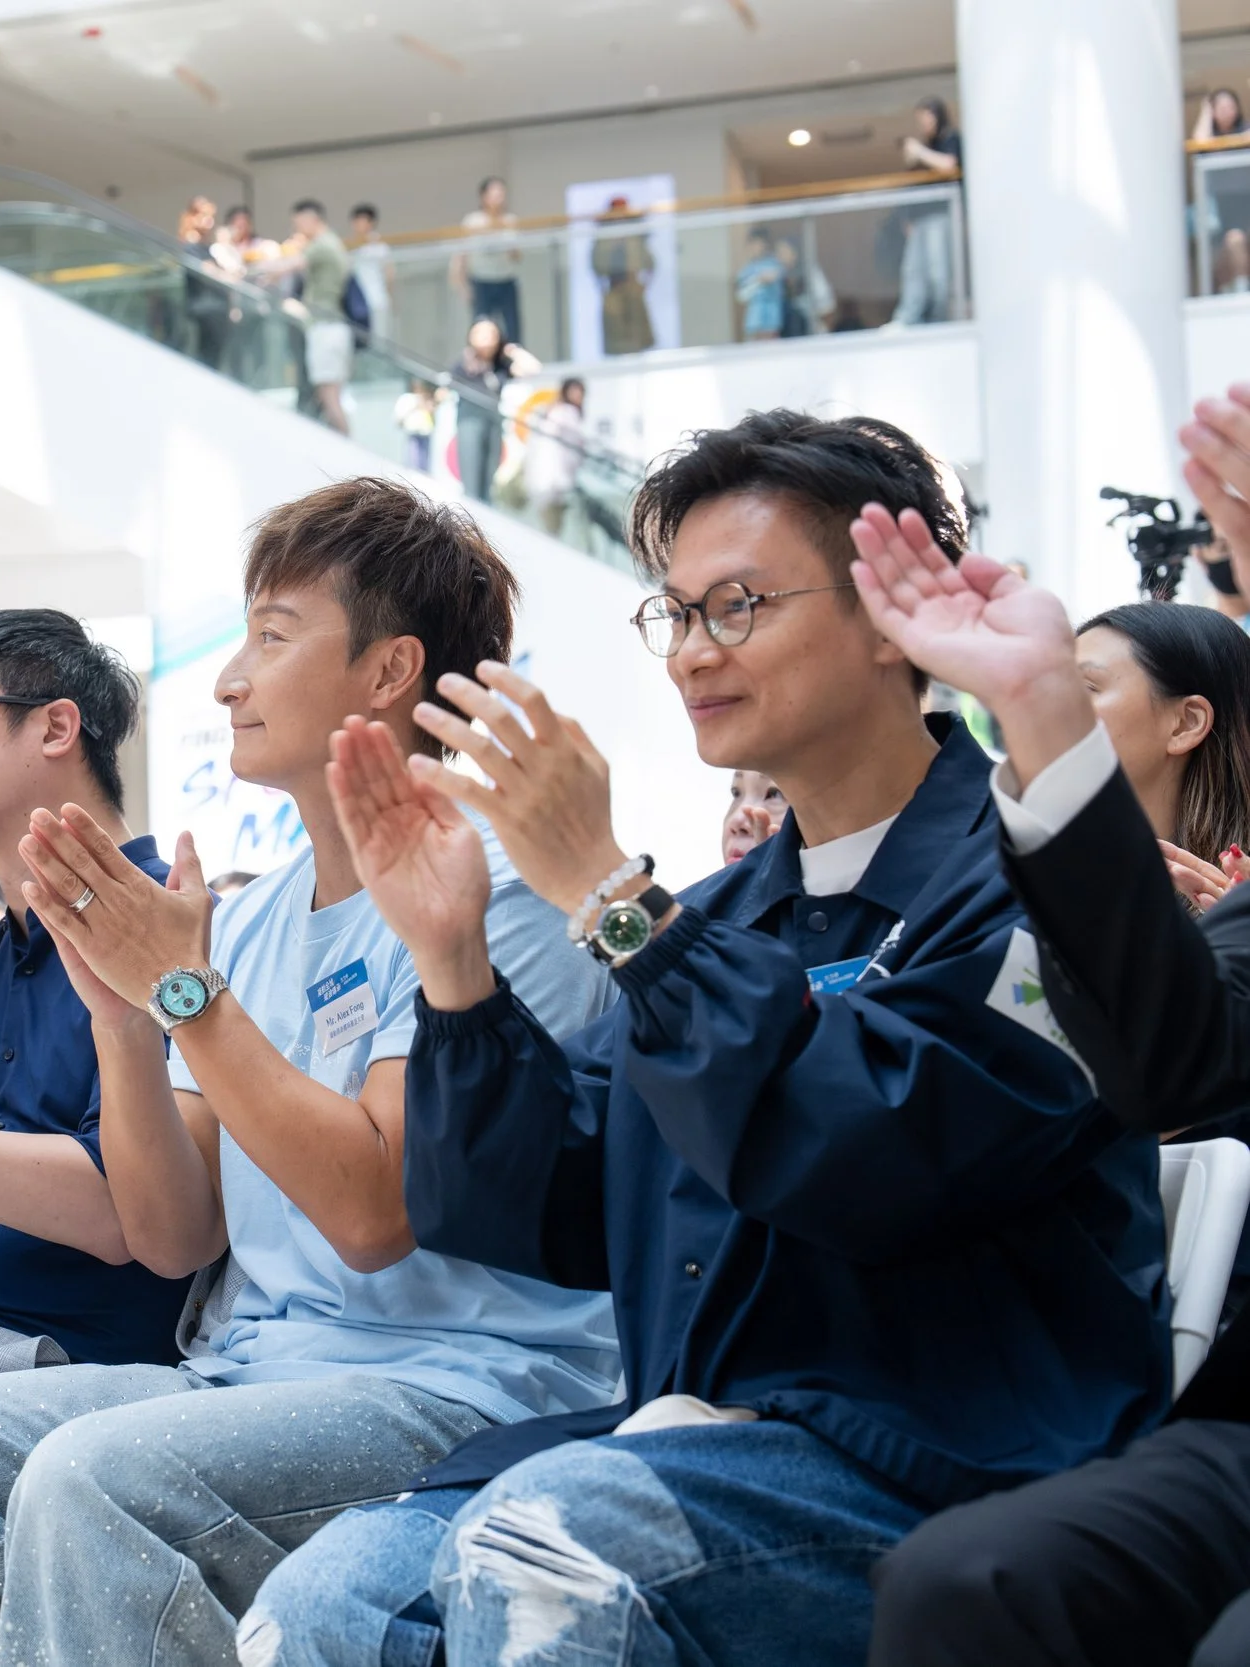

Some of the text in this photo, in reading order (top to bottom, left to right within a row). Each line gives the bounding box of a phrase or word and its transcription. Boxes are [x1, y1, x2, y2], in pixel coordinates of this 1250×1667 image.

[326, 1017, 337, 1027] Mr.
[337, 1010, 350, 1022] Alex
[349, 1001, 365, 1015] Fong
